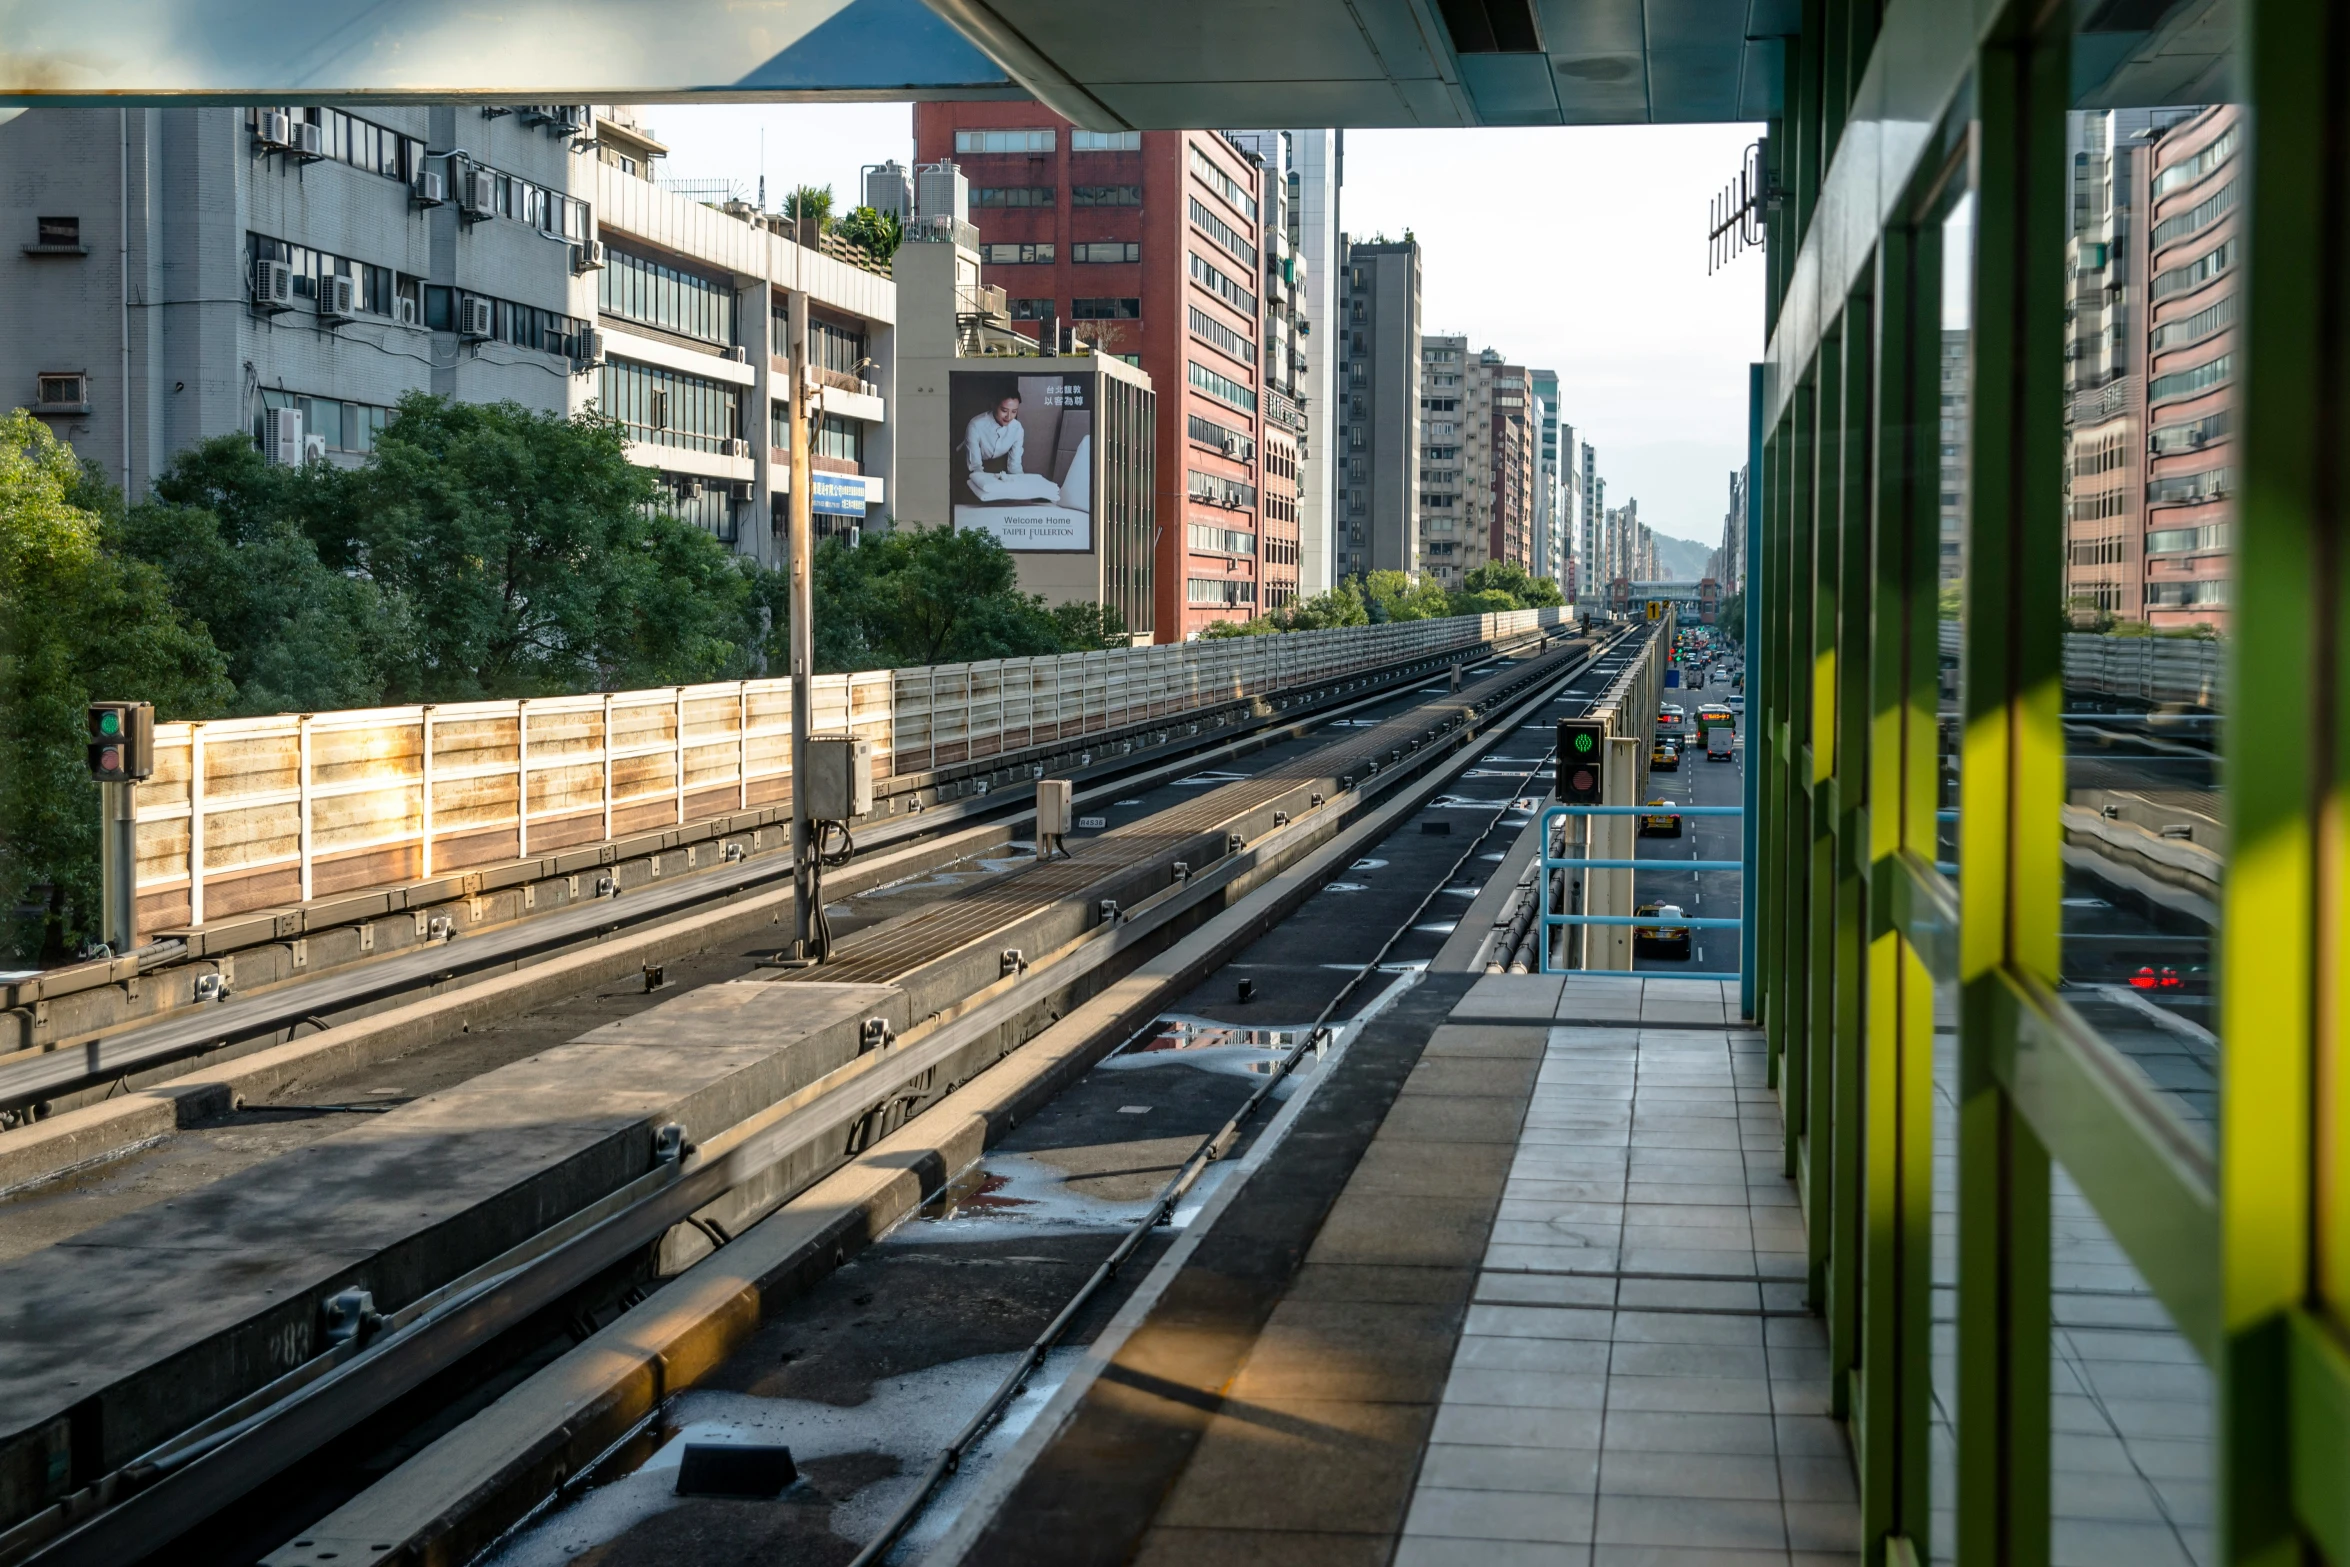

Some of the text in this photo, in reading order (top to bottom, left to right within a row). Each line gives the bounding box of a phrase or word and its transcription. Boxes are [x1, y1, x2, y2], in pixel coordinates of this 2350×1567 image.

[1046, 385, 1081, 394] 台北馥敦
[1044, 396, 1084, 406] 以客為尊
[1003, 516, 1071, 525] Welcome Home
[1002, 528, 1074, 540] TAIPEI FULLERTON
